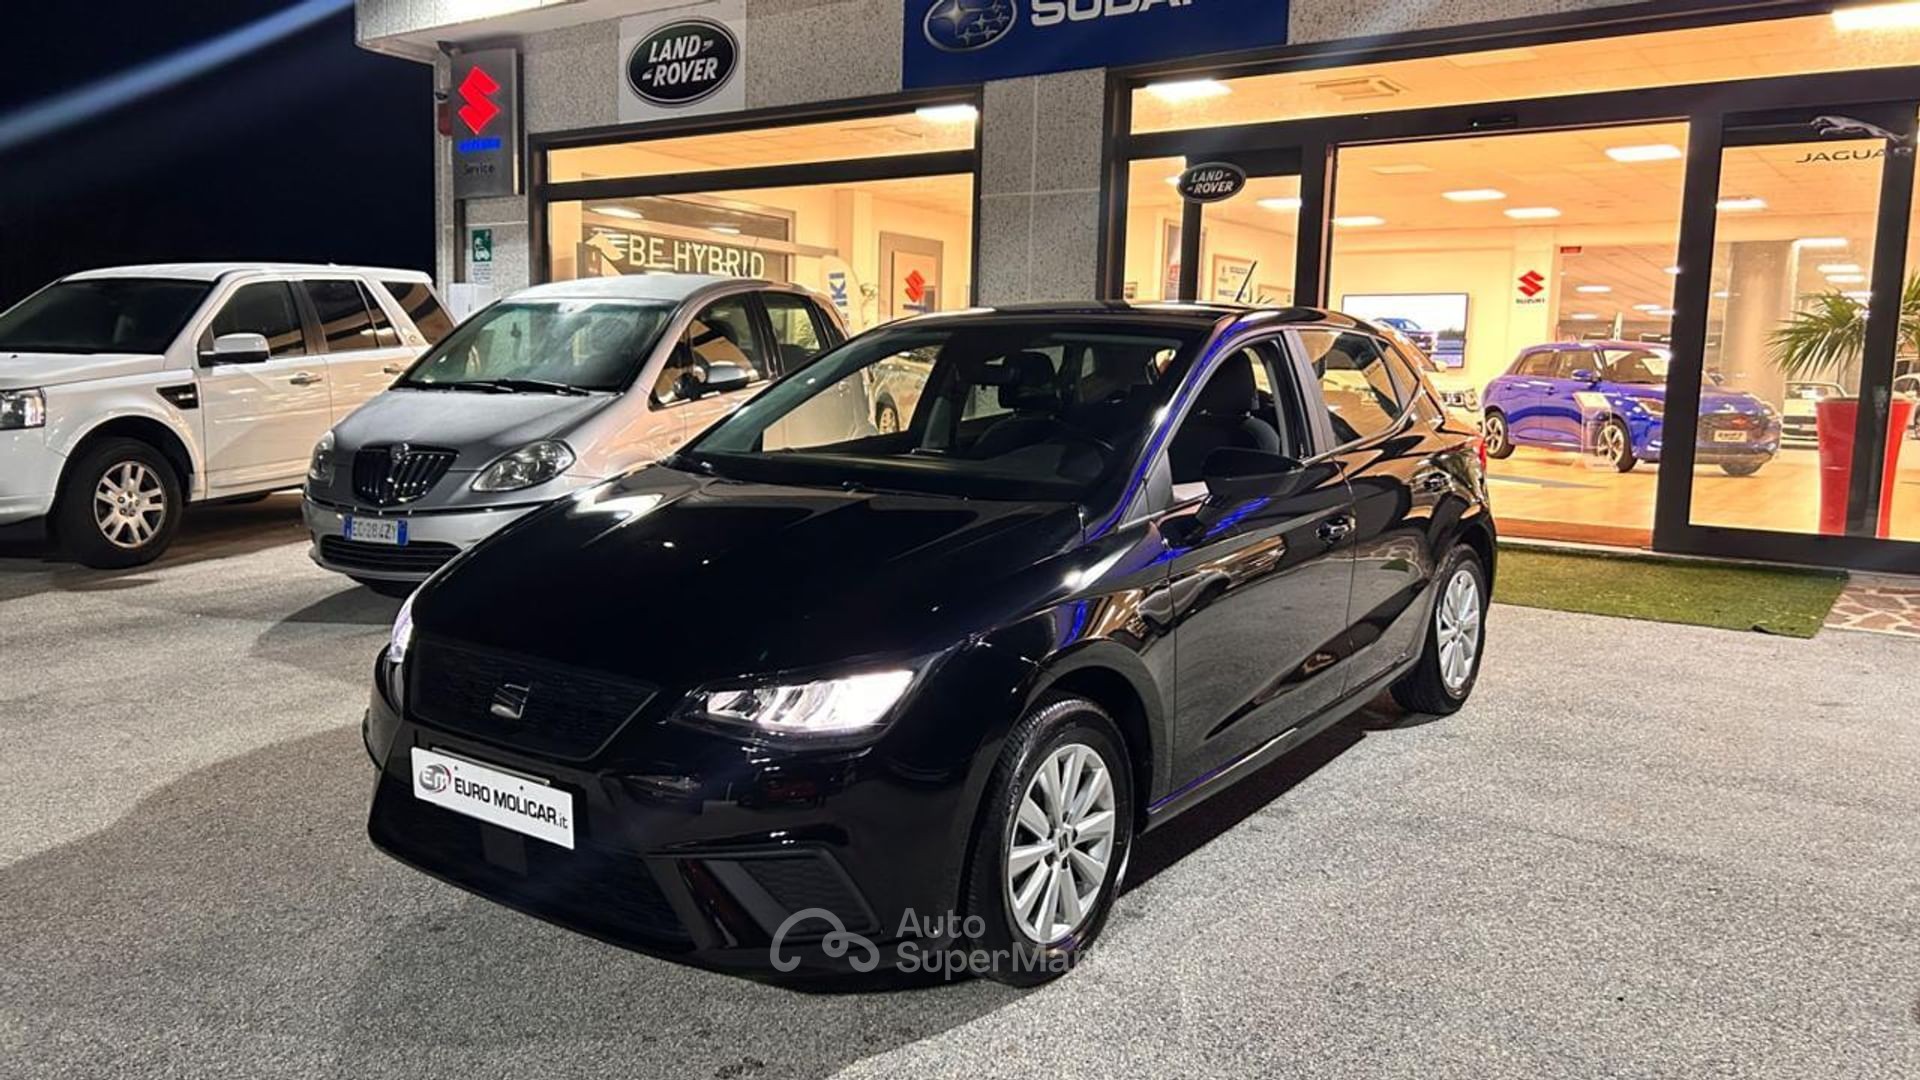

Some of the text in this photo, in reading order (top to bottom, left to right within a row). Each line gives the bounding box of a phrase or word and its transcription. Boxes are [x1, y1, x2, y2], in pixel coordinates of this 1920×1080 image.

[629, 234, 765, 279] BE HYBRID
[455, 777, 491, 803] EURO
[493, 789, 569, 829] MOLICAR.it
